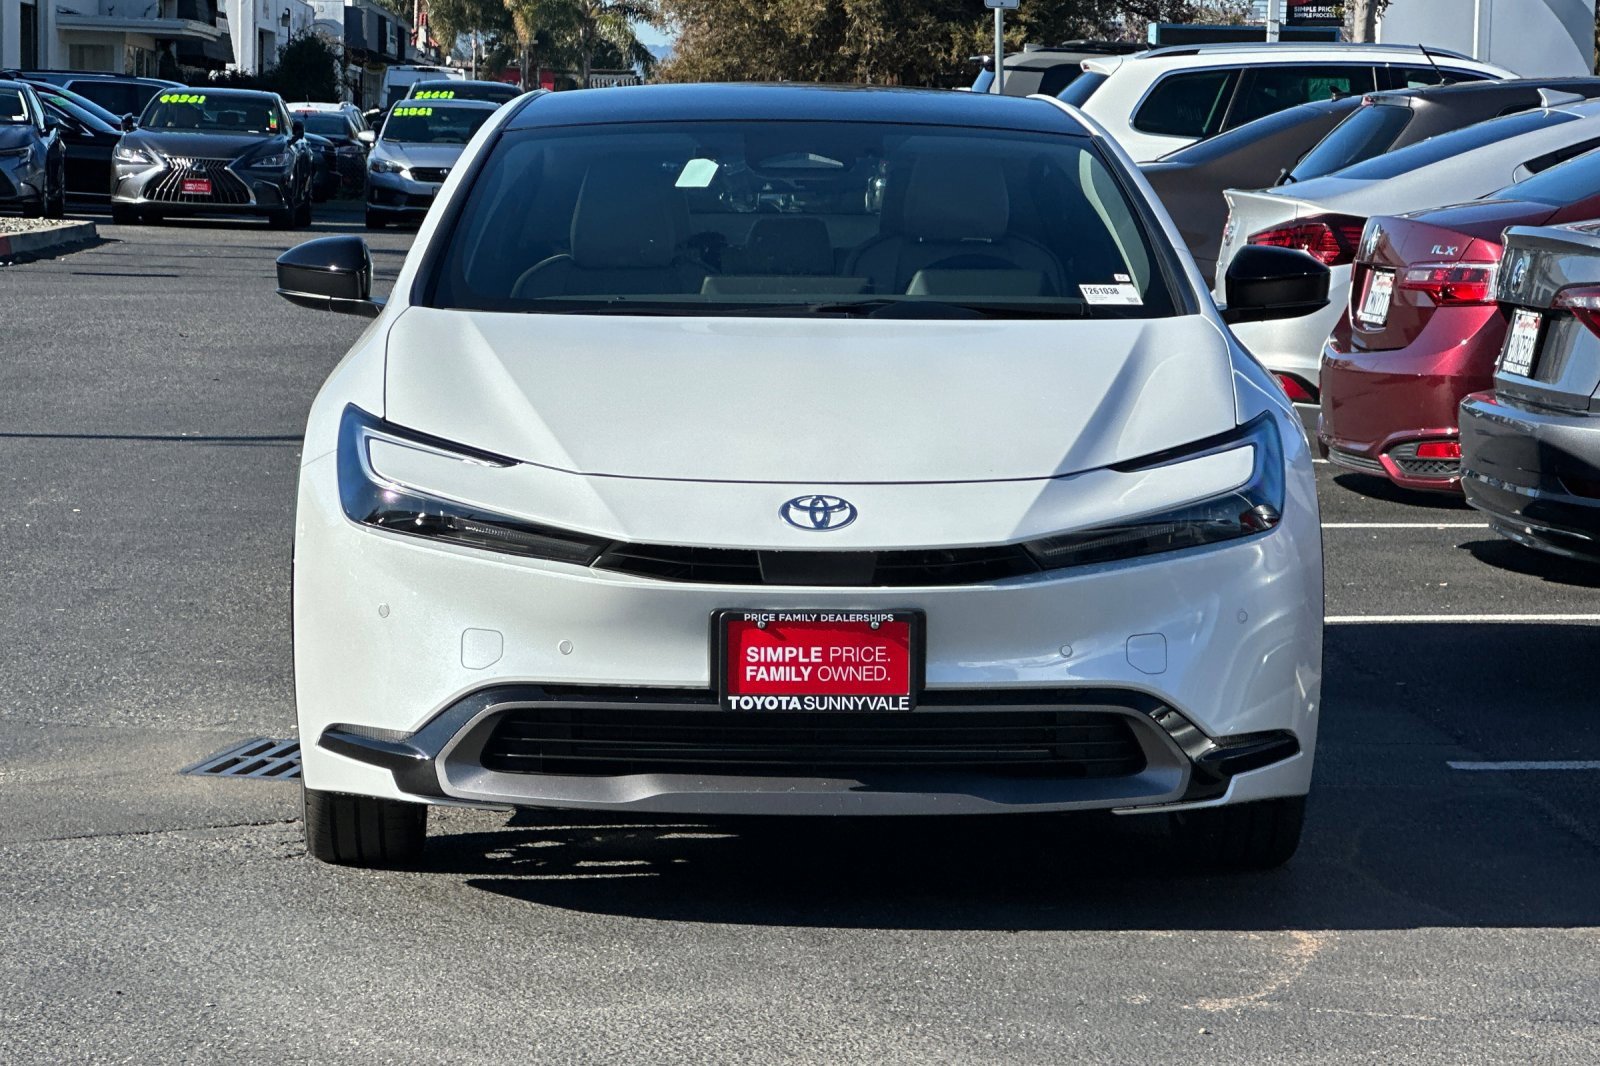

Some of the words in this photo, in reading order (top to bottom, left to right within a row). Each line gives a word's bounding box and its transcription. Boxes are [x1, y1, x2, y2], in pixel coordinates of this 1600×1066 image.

[1431, 245, 1458, 255] ILX
[1083, 287, 1119, 295] T261038
[779, 613, 817, 622] FAMILY
[820, 613, 894, 622] DEALERSHIPS
[747, 647, 822, 662] SIMPLE
[829, 647, 890, 662] PRICE.
[746, 666, 812, 681] FAMILY
[817, 665, 890, 681] OWNED.
[728, 696, 801, 709] TOYOTA
[803, 696, 909, 710] SUNNYVALE
